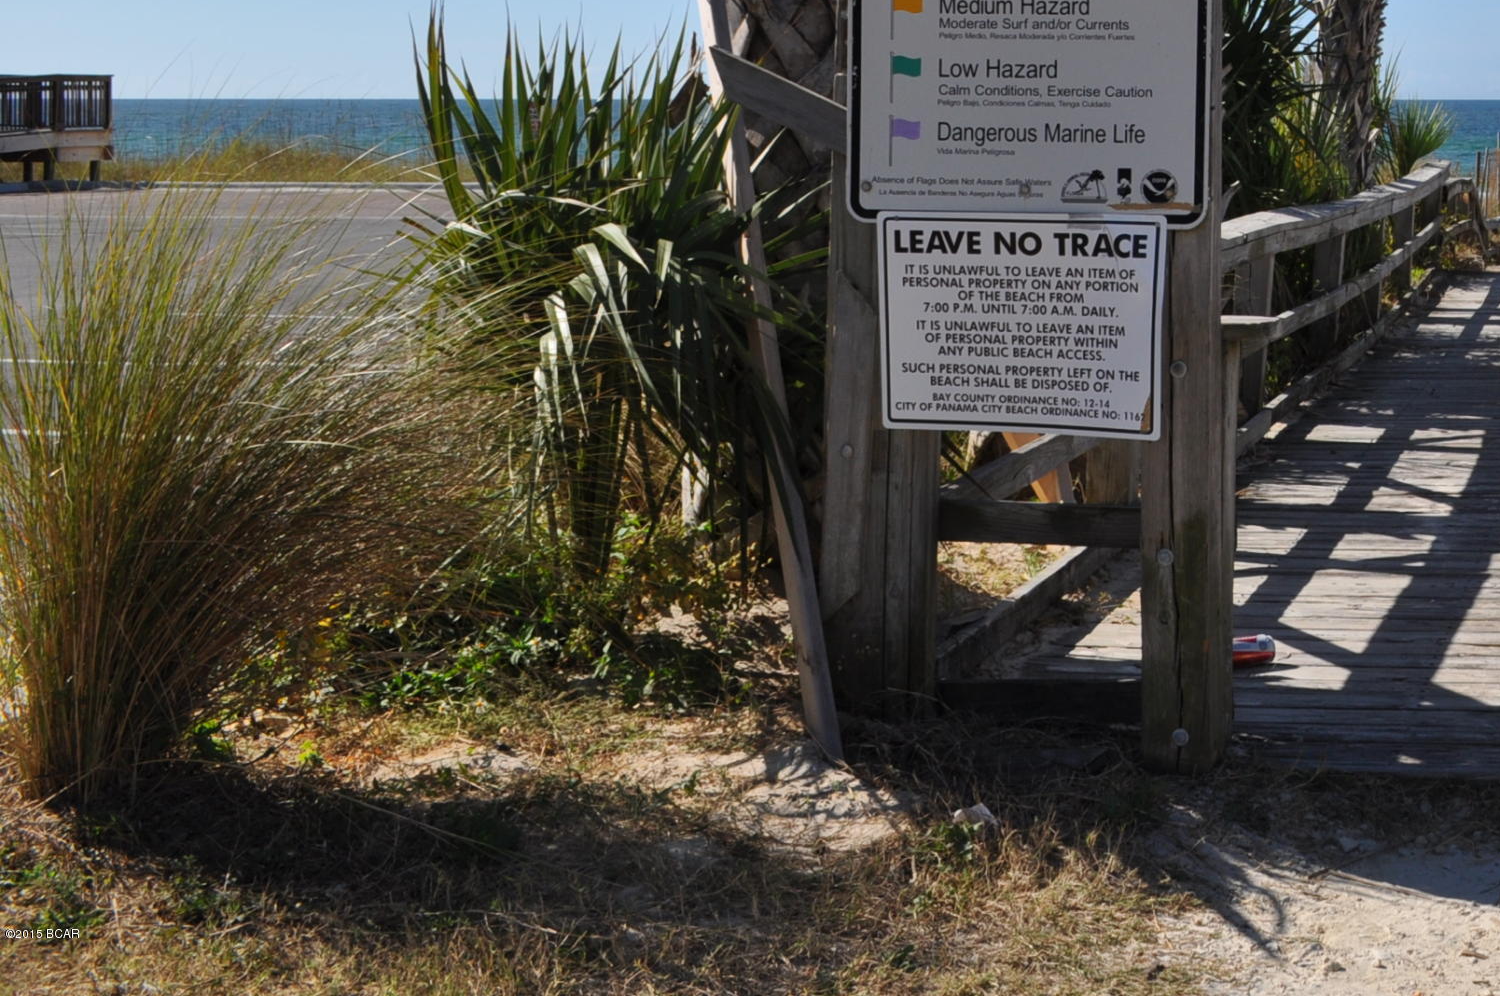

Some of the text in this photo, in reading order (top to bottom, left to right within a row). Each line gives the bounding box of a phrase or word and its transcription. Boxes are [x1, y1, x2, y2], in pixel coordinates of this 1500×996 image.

[939, 17, 1130, 31] Moderate Surf and/or Currents
[938, 58, 1058, 79] Low Hazard
[938, 84, 1153, 98] Calm Conditions, Exercise Caution
[937, 121, 1146, 147] Dangerous Marine Life
[894, 229, 1148, 259] LEAVE NO TRACE
[905, 264, 1135, 280] IT IS UNLAWFUL TO LEAVE AN ITEM OF
[902, 276, 1138, 293] PERSONAL PROPERTY ON ANY PORTION
[957, 290, 1084, 304] OF THE BEACH FROM
[923, 302, 1119, 318] 7:00 P.M. UNTIL 7:00 A.M. DAILY.
[916, 320, 1125, 336] IT IS UNLAWFUL TO LEAVE AN ITEM
[925, 332, 1118, 349] OF PERSONAL PROPERTY WITHIN
[938, 345, 1105, 361] ANY PUBLIC BEACH ACCESS.
[902, 362, 1139, 382] SUCH PERSONAL PROPERTY LEFT ON THE
[930, 375, 1112, 393] BEACH SHALL BE DISPOSED OF.
[932, 392, 1110, 408] BAY COUNTY ORDINANCE NO: 12-14
[895, 401, 917, 411] CITY
[919, 402, 933, 411] OF
[936, 403, 979, 412] PANAMA
[981, 404, 1003, 414] CITY
[1005, 405, 1038, 415] BEACH
[1040, 406, 1099, 419] ORDINANCE
[1102, 410, 1120, 420] NO:
